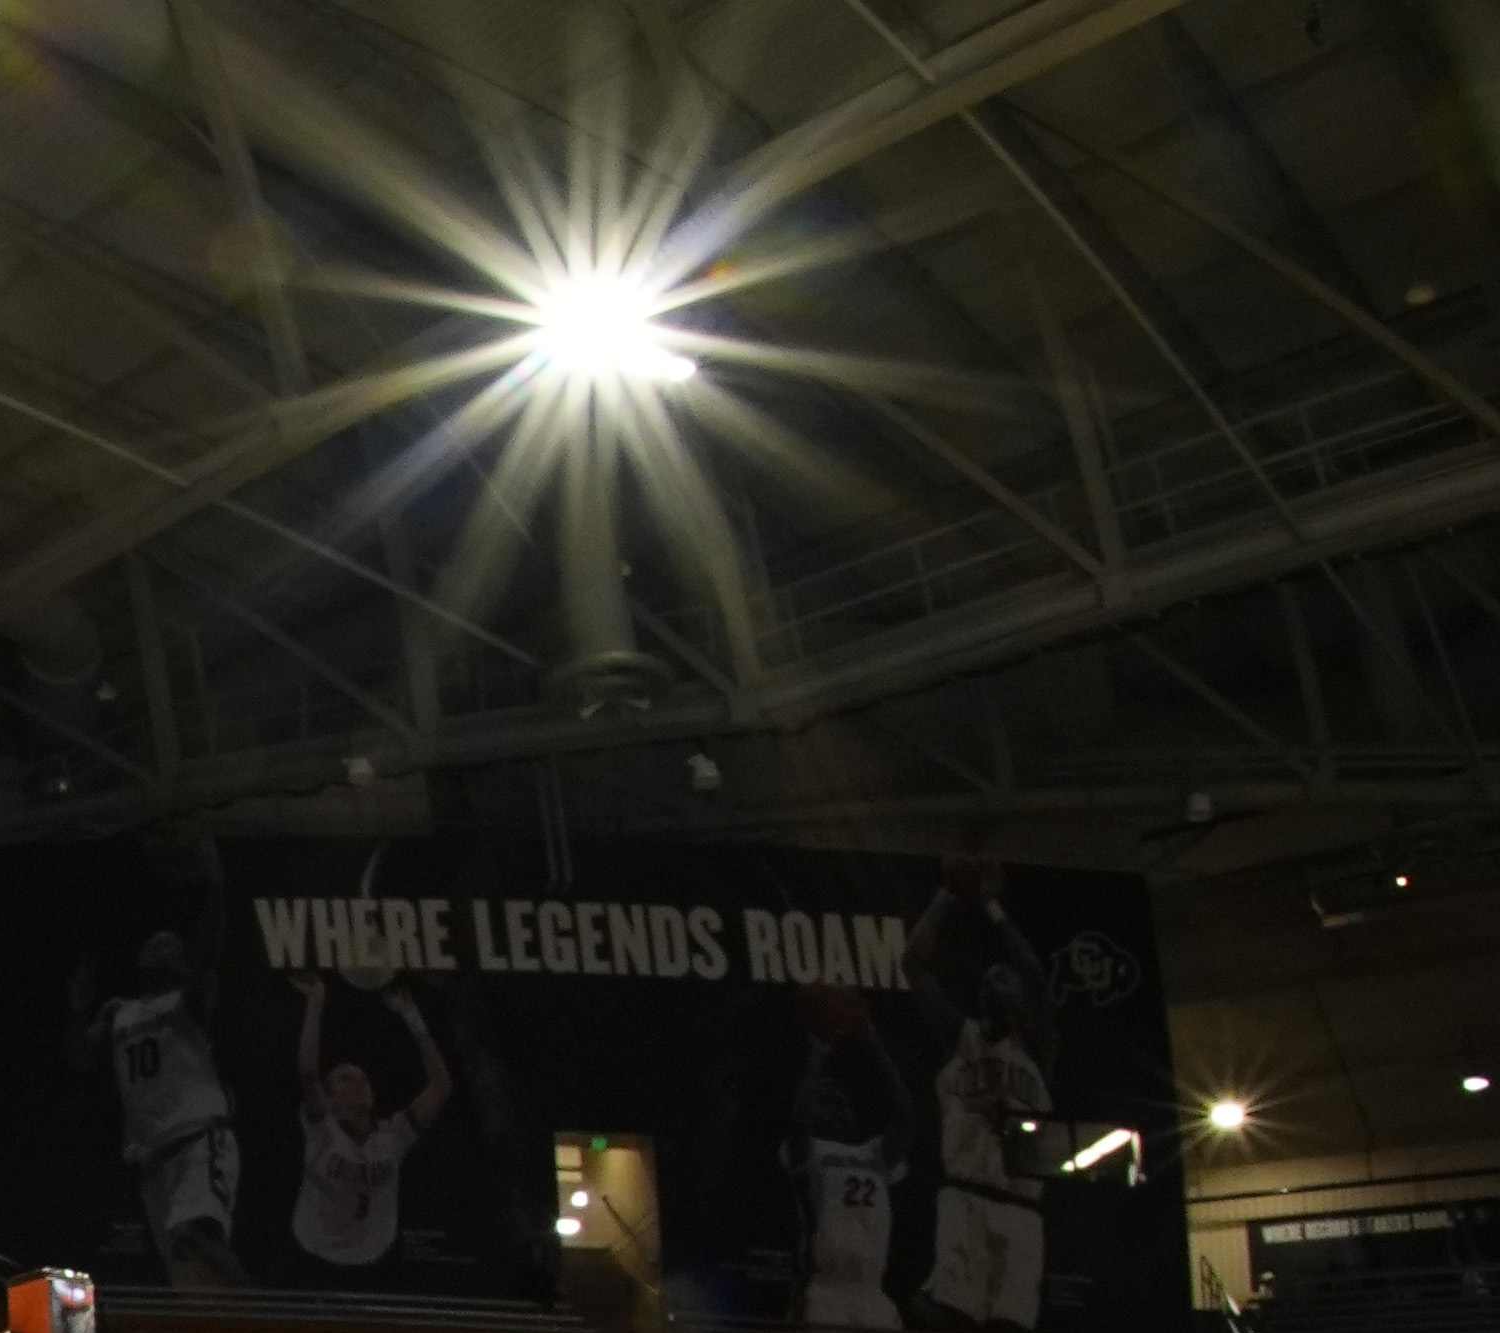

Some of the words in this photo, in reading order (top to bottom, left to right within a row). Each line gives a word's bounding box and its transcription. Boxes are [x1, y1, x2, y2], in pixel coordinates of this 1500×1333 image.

[253, 898, 456, 969] WHERE
[472, 899, 729, 980] LEGENDS
[743, 909, 909, 990] ROAM
[125, 1036, 160, 1083] 10
[843, 1175, 877, 1208] 22
